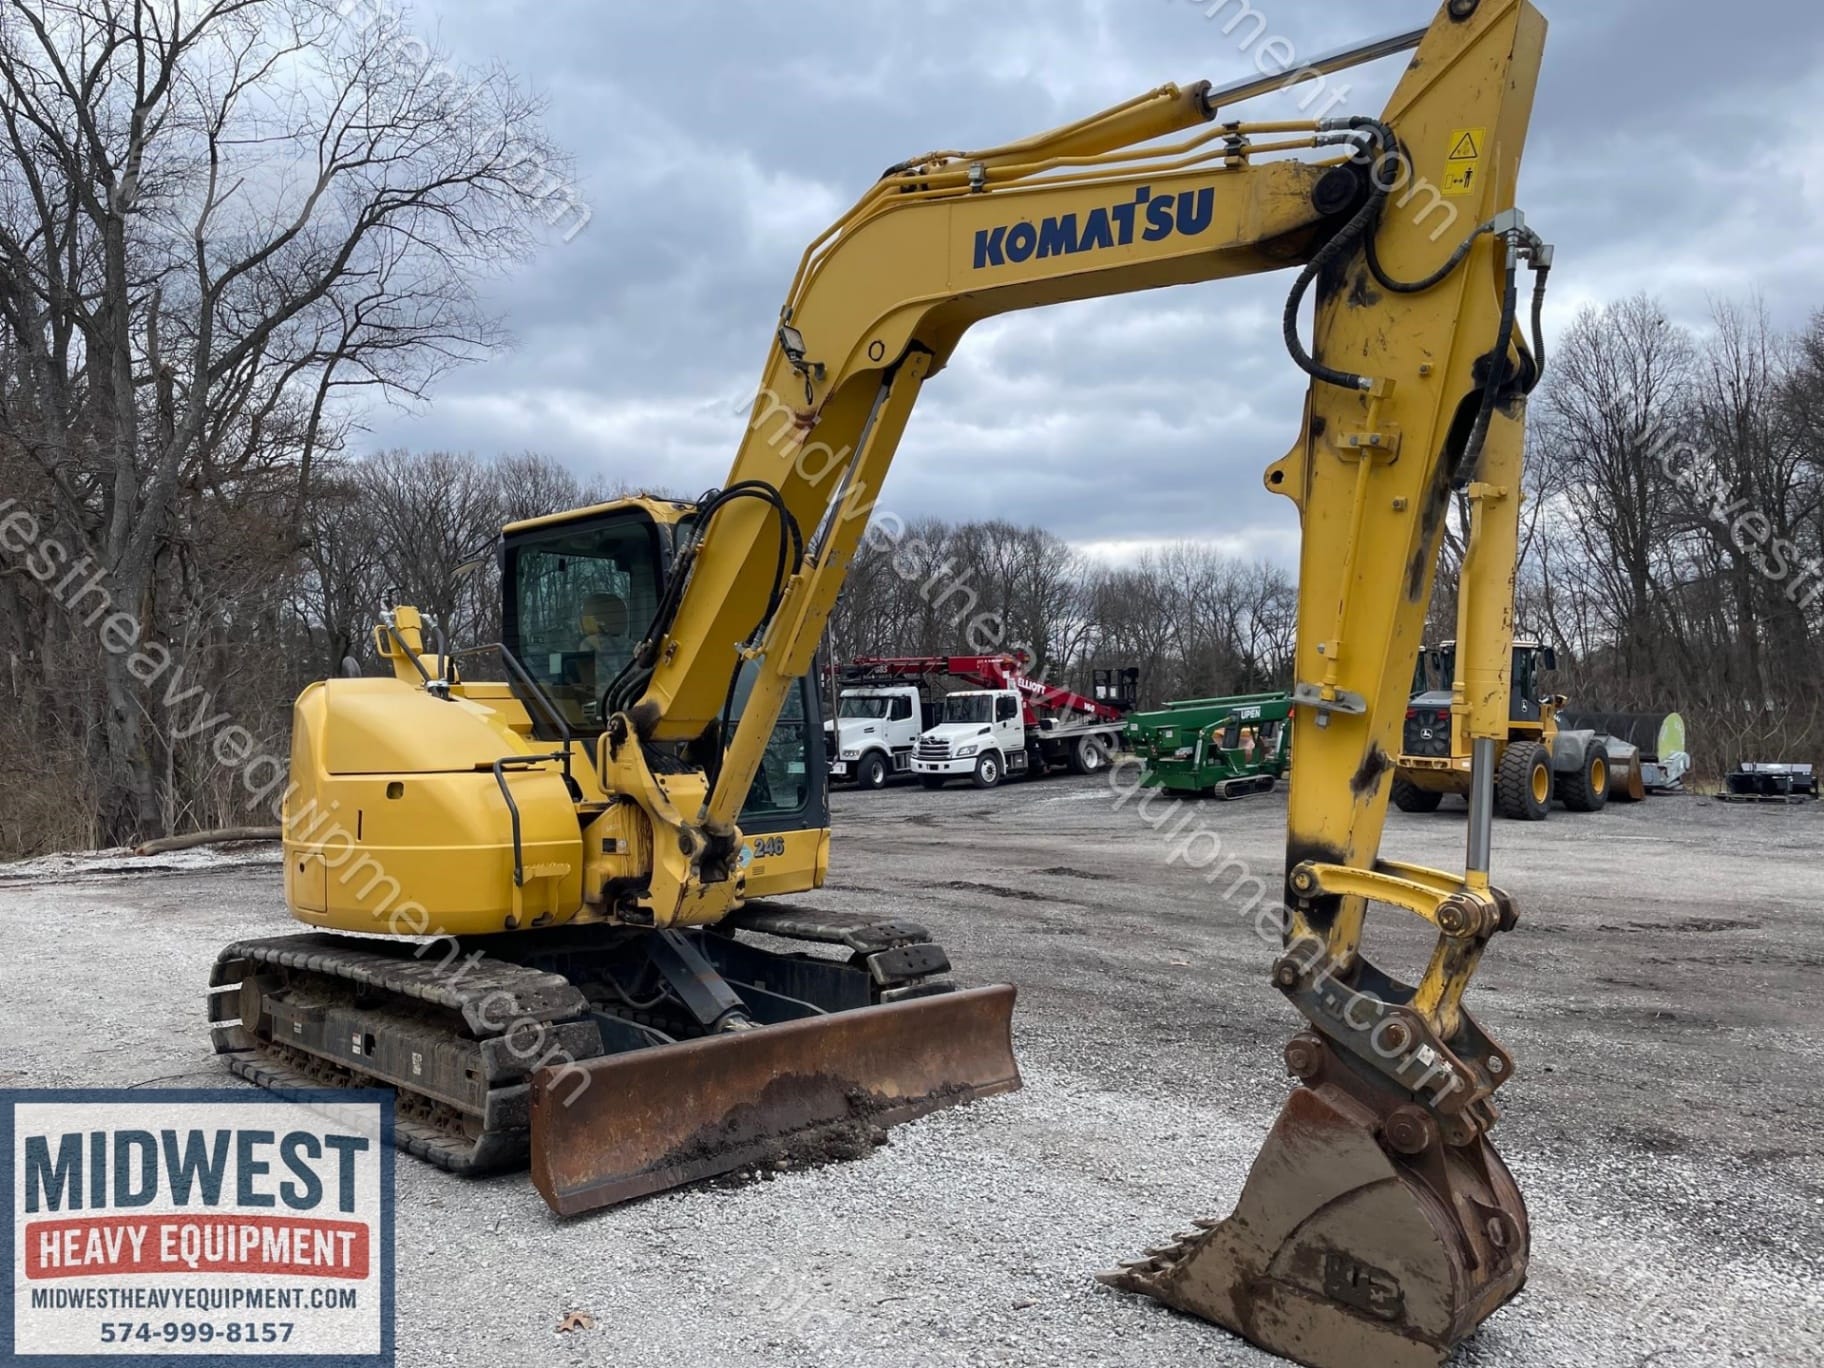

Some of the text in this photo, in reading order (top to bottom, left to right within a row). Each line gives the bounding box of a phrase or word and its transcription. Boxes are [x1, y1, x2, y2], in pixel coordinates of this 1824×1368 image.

[973, 186, 1215, 269] KOMATSU
[1017, 677, 1047, 695] ELLIOTT
[754, 836, 785, 859] 246
